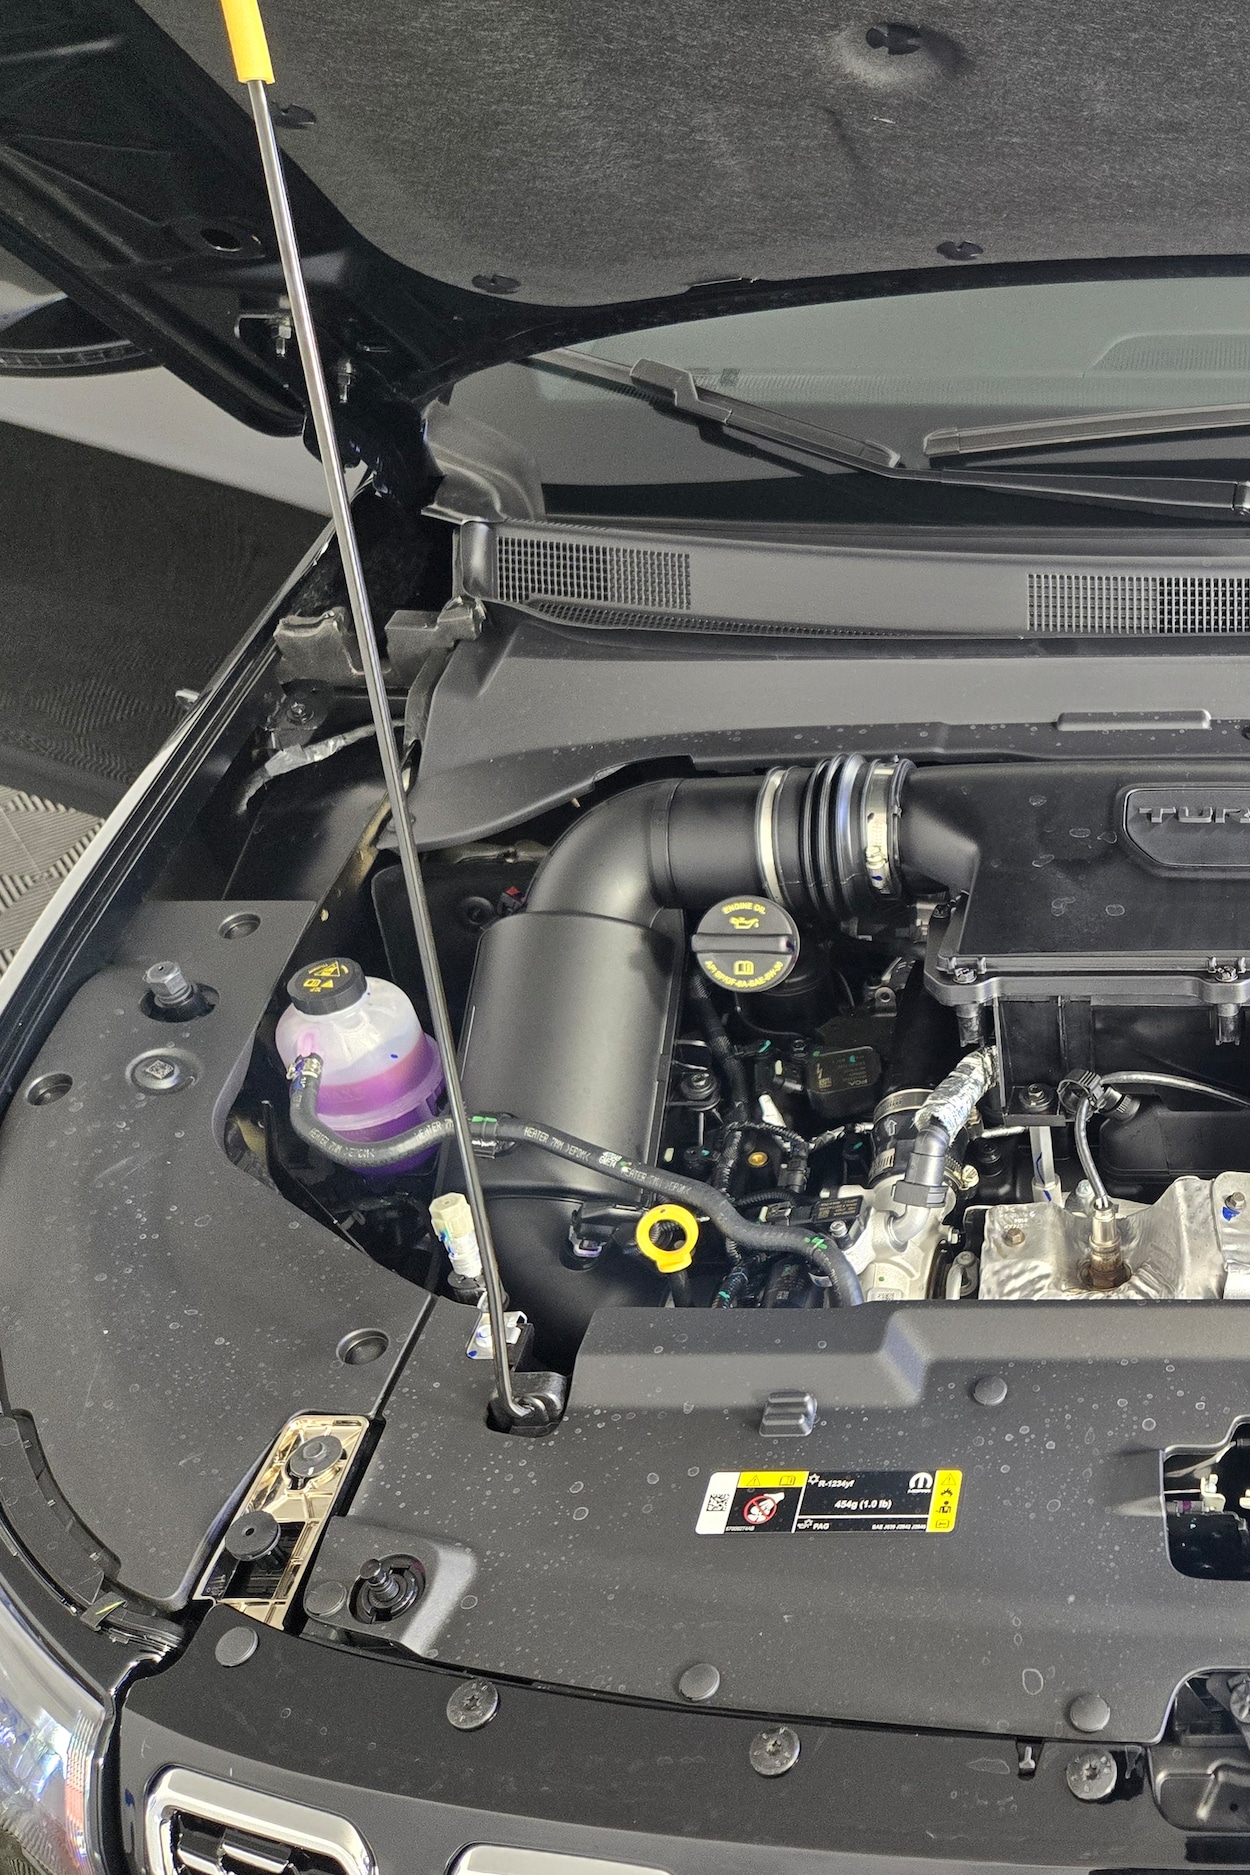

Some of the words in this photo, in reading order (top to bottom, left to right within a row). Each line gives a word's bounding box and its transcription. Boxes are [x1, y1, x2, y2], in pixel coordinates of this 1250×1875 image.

[721, 902, 754, 915] ENGINE
[753, 903, 767, 915] OIL
[524, 1127, 549, 1144] HEATER
[818, 1479, 855, 1489] R-1234yf
[834, 1499, 859, 1510] 454g
[859, 1499, 878, 1510] (1.0
[878, 1499, 892, 1510] lb)
[812, 1522, 830, 1531] PAG
